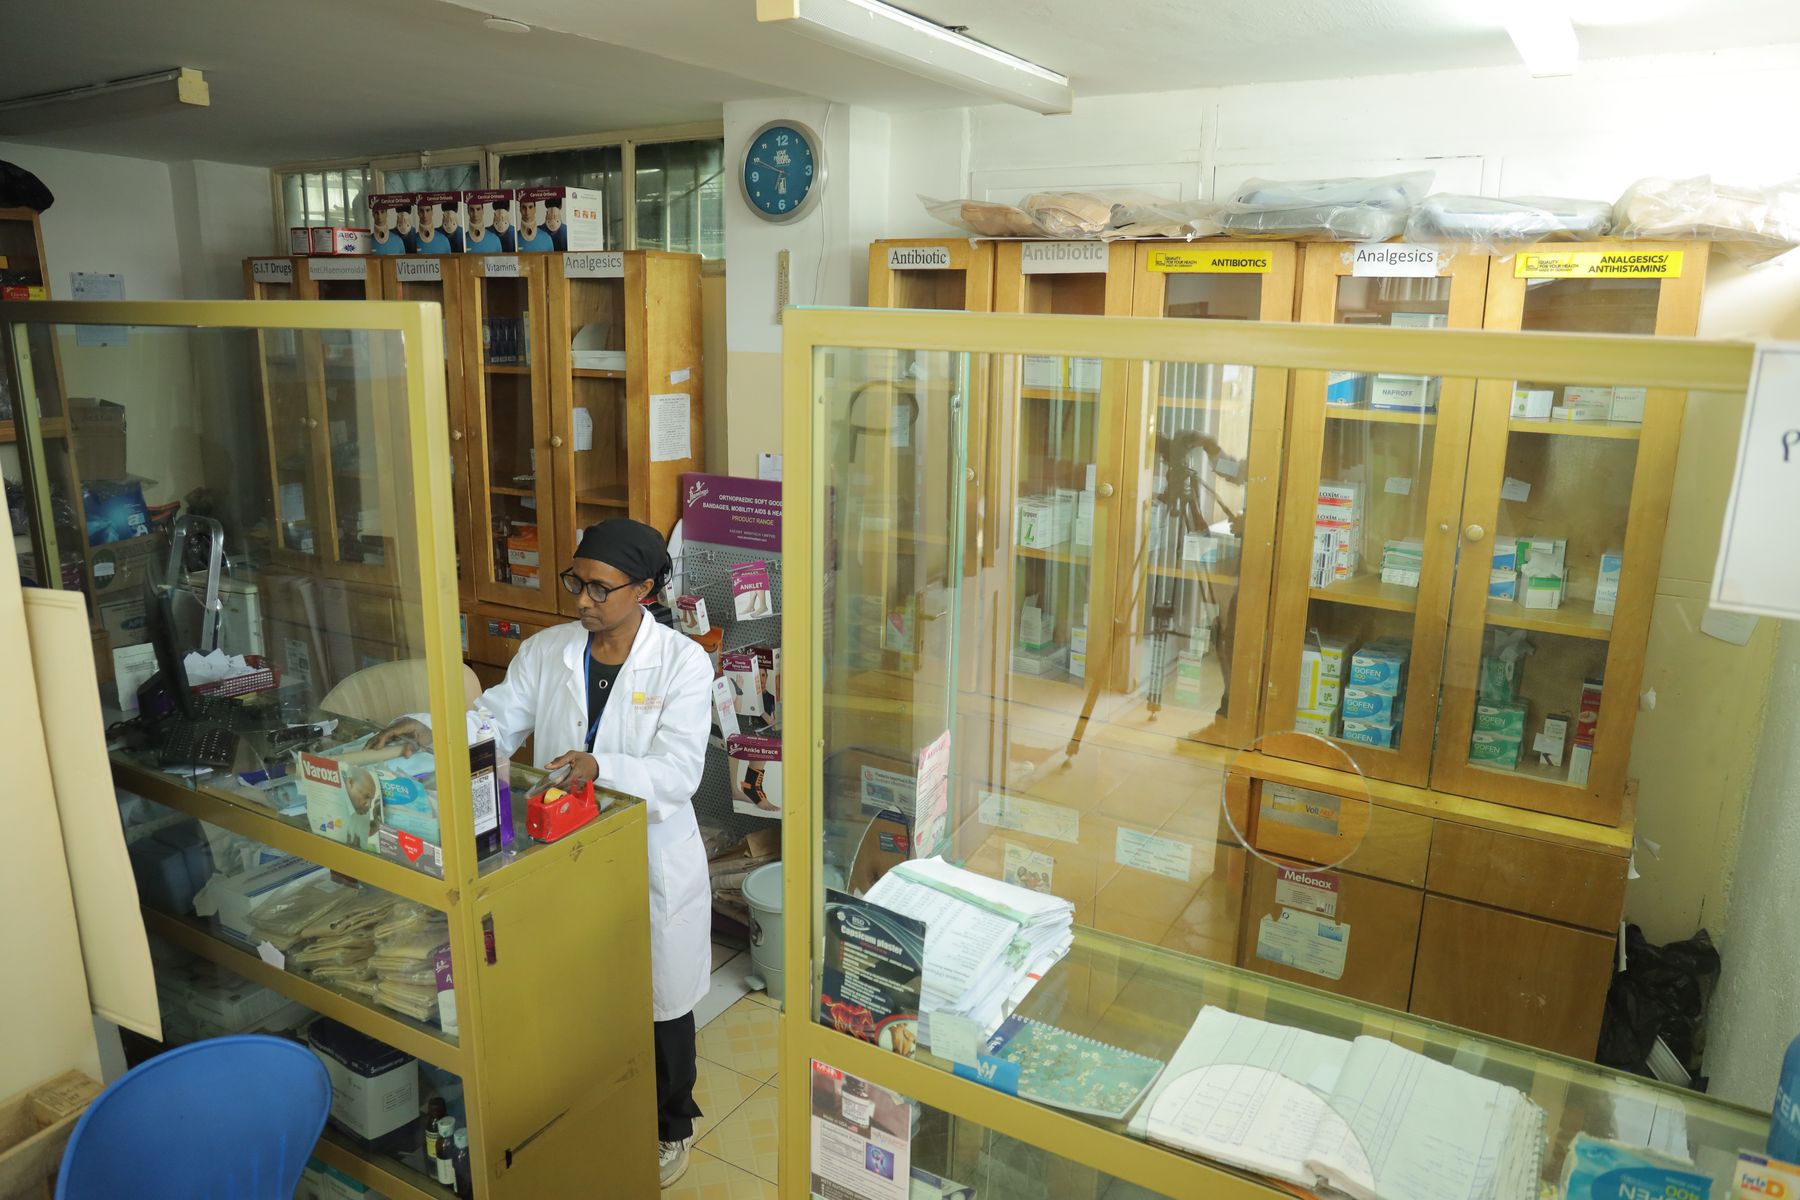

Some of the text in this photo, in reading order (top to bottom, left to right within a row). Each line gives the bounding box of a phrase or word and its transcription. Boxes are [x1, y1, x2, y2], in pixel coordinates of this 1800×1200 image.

[776, 135, 789, 146] 12
[805, 165, 812, 176] 3
[751, 172, 759, 182] 9
[778, 200, 786, 210] 6
[890, 249, 947, 265] Antibiotic
[1022, 244, 1103, 261] Antibiotic
[1356, 249, 1434, 266] Analgesics
[565, 253, 622, 272] Analgesics
[1211, 258, 1267, 268] ANTIBIOTICS
[1600, 255, 1669, 264] ANALGESICS/
[253, 263, 292, 276] G.I.T Drugs
[397, 260, 440, 275] Vitamins
[486, 263, 517, 272] Vitamins
[1588, 265, 1667, 273] ANTIHISTAMINS
[718, 494, 754, 504] ORTHOPAEDIC
[754, 497, 768, 505] SOFT
[702, 502, 731, 512] BANDAGES,
[731, 505, 754, 514] MOBILITY
[732, 515, 774, 526] PRODUCT RANGE
[740, 582, 763, 590] ANKLET
[1354, 666, 1381, 677] GOFEN
[1347, 699, 1374, 710] GOFEN
[1479, 714, 1505, 725] GOFEN
[1346, 732, 1373, 742] GOFEN
[1474, 743, 1500, 753] GOFEN
[303, 760, 340, 785] Varoxa
[1284, 869, 1332, 890] Melonax
[841, 924, 903, 956] Capsicum plaster
